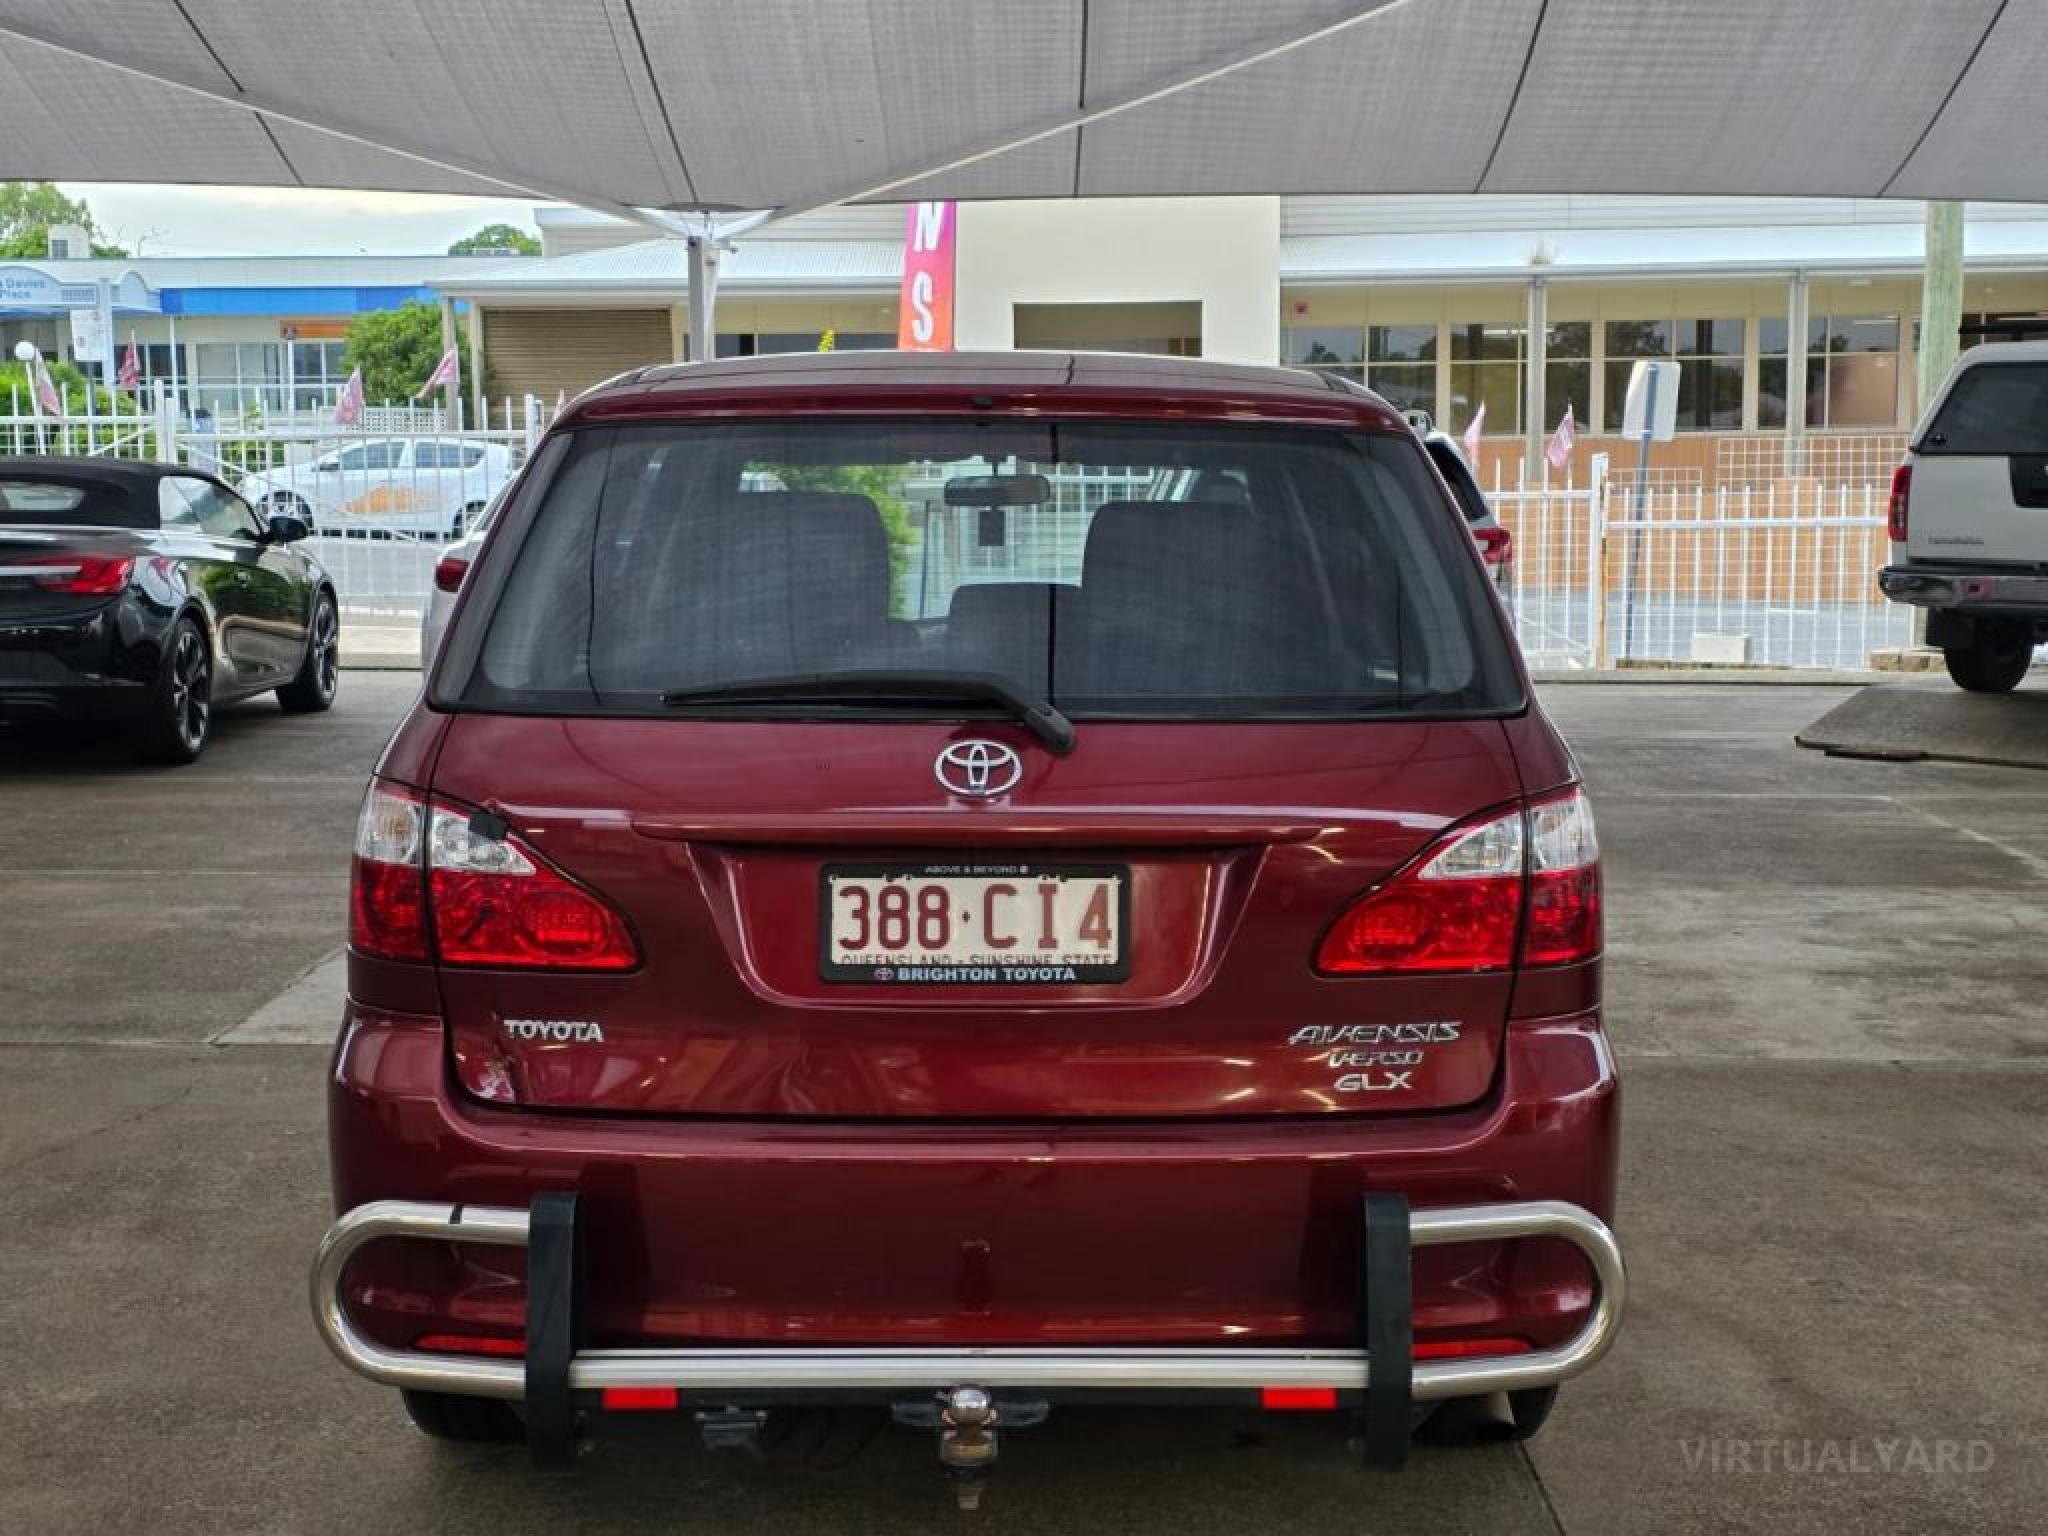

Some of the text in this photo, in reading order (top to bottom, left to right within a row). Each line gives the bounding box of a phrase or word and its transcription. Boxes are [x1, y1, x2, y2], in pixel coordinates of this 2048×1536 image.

[925, 865, 961, 873] ABOVE
[973, 865, 1017, 873] BEYOND
[897, 967, 1077, 982] BRIGHTON TOYOTA
[503, 1019, 605, 1043] TOYOTA
[1288, 1021, 1463, 1045] AVENSIS
[1334, 1071, 1413, 1092] GLX
